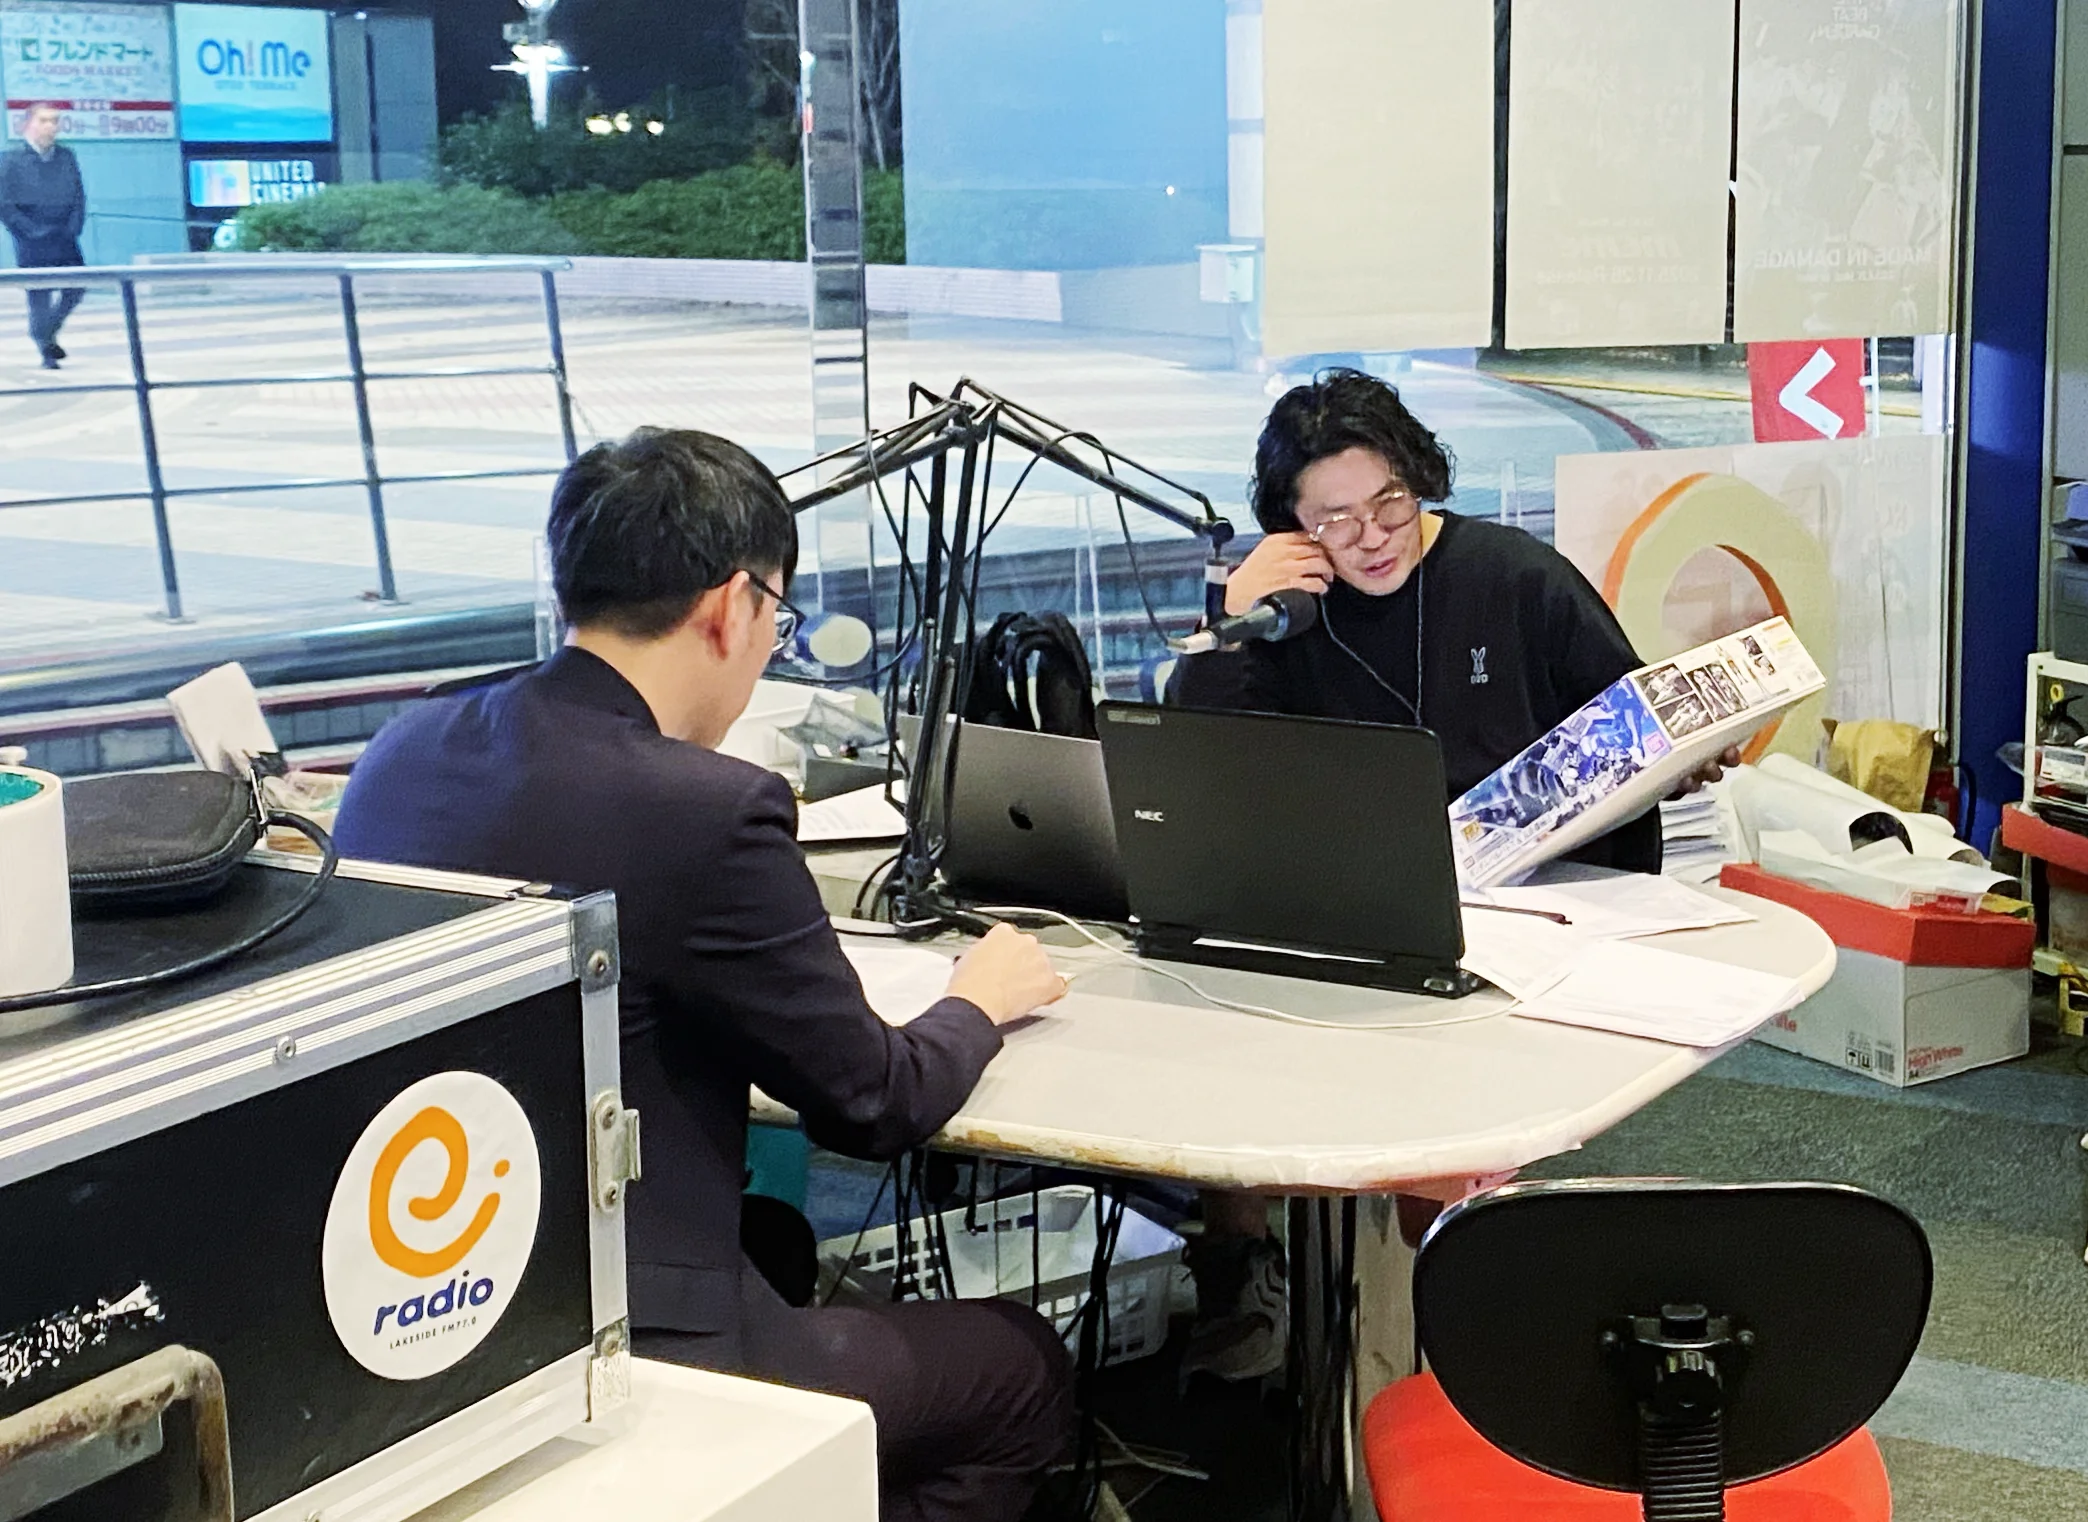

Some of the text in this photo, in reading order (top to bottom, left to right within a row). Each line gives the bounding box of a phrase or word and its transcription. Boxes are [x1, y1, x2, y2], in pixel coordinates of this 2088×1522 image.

[46, 40, 153, 62] フレンドマート
[1134, 809, 1165, 823] NEC
[373, 1269, 494, 1336] radio
[389, 1328, 438, 1350] LAKESIDE
